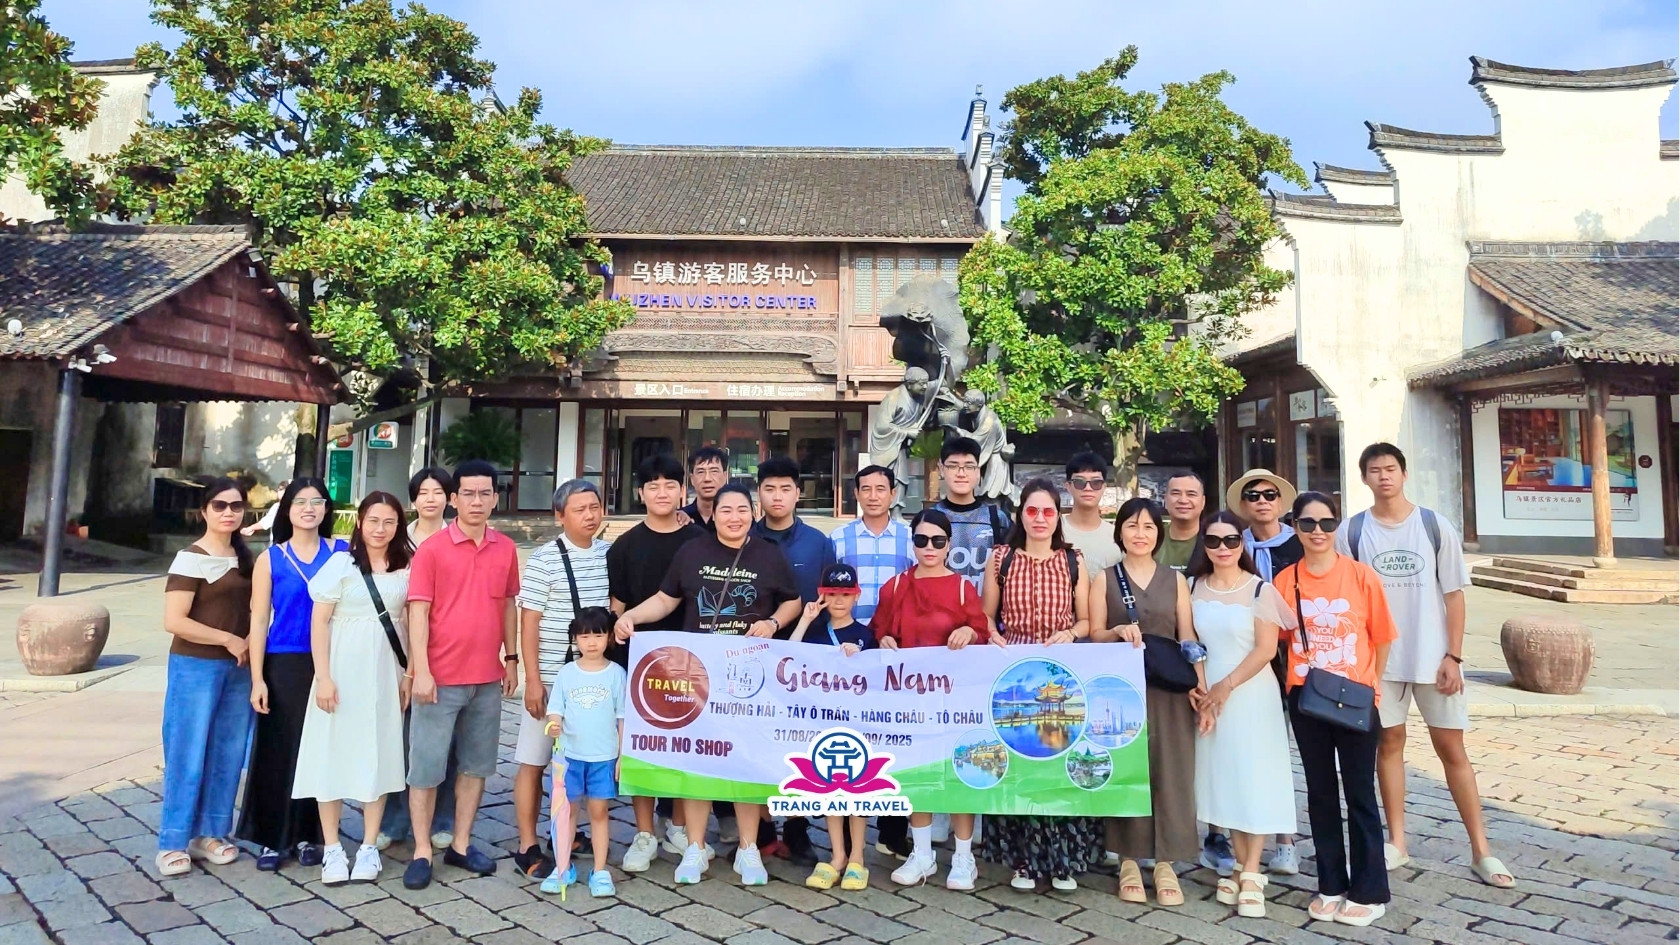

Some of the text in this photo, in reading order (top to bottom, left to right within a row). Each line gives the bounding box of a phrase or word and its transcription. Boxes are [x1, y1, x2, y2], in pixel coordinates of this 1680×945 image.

[630, 260, 818, 285] 乌镇游客服务中心
[686, 294, 750, 308] VISITOR
[755, 295, 817, 309] CENTER
[634, 383, 684, 396] 景区入口
[726, 384, 775, 397] 住宿办理
[726, 649, 739, 658] Du
[776, 656, 868, 695] Giang
[884, 662, 954, 694] Nam
[647, 678, 695, 692] TRAVEL
[664, 694, 695, 703] Together
[709, 702, 754, 717] THƯỢNG
[787, 706, 807, 718] TÂY
[810, 705, 818, 719] Ô
[861, 709, 891, 723] HÀNG
[895, 709, 925, 723] CHÂU
[953, 710, 983, 724] CHÂU
[630, 734, 733, 757] TOUR NO SHOP
[885, 734, 912, 746] 2025
